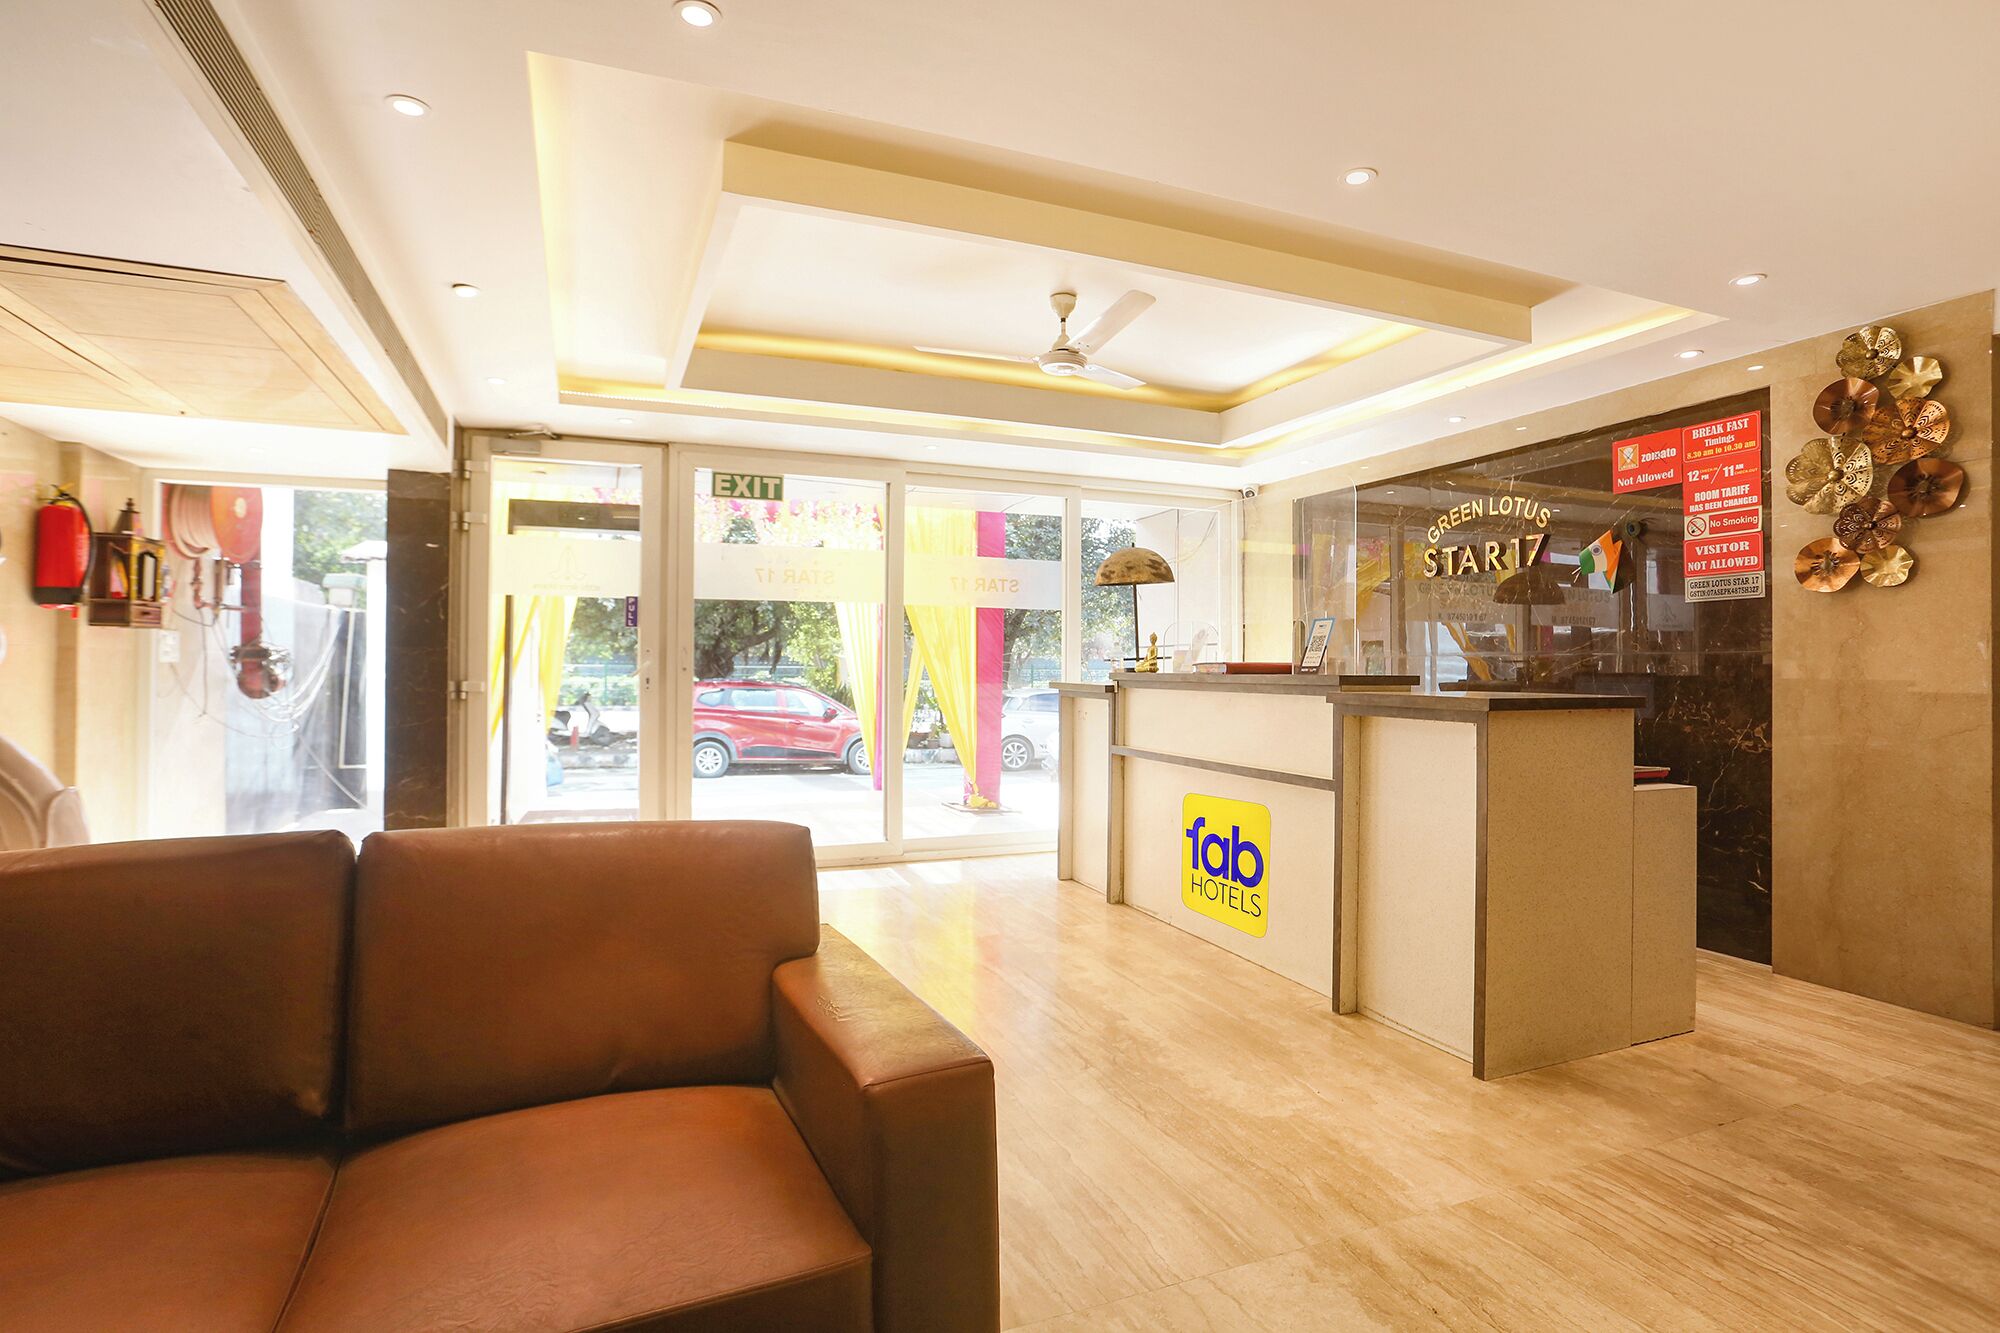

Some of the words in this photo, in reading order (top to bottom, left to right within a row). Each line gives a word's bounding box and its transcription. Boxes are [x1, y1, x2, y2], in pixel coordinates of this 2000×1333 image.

[1692, 423, 1724, 440] BREAK
[1726, 418, 1750, 431] FAST
[1704, 433, 1735, 447] Timings
[1687, 451, 1702, 460] 8.30
[1703, 449, 1714, 457] am
[1724, 443, 1743, 453] 10.30
[1744, 440, 1756, 449] am
[1617, 476, 1633, 487] Not
[1636, 468, 1674, 484] Allowed
[1687, 470, 1699, 482] 12
[1723, 465, 1734, 477] 11
[714, 474, 781, 498] EXIT
[1694, 489, 1719, 502] ROOM
[1721, 484, 1750, 497] TARIFF
[1690, 503, 1703, 512] HAS
[1705, 501, 1722, 510] BEEN
[1723, 495, 1758, 507] CHANGED
[1427, 499, 1483, 544] GREEN
[1488, 495, 1551, 528] LOTUS
[1723, 515, 1758, 526] Smoking
[1423, 541, 1503, 578] STAR
[1510, 533, 1545, 568] 17
[1695, 541, 1750, 556] VISITOR
[1688, 561, 1707, 571] NOT
[1710, 556, 1758, 569] ALLOWED
[1690, 580, 1710, 589] GREEN
[1712, 578, 1731, 588] LOTUS
[1733, 577, 1750, 586] STAR
[1752, 576, 1759, 584] 17
[1186, 816, 1264, 888] fab
[1192, 874, 1261, 917] HOTELS
